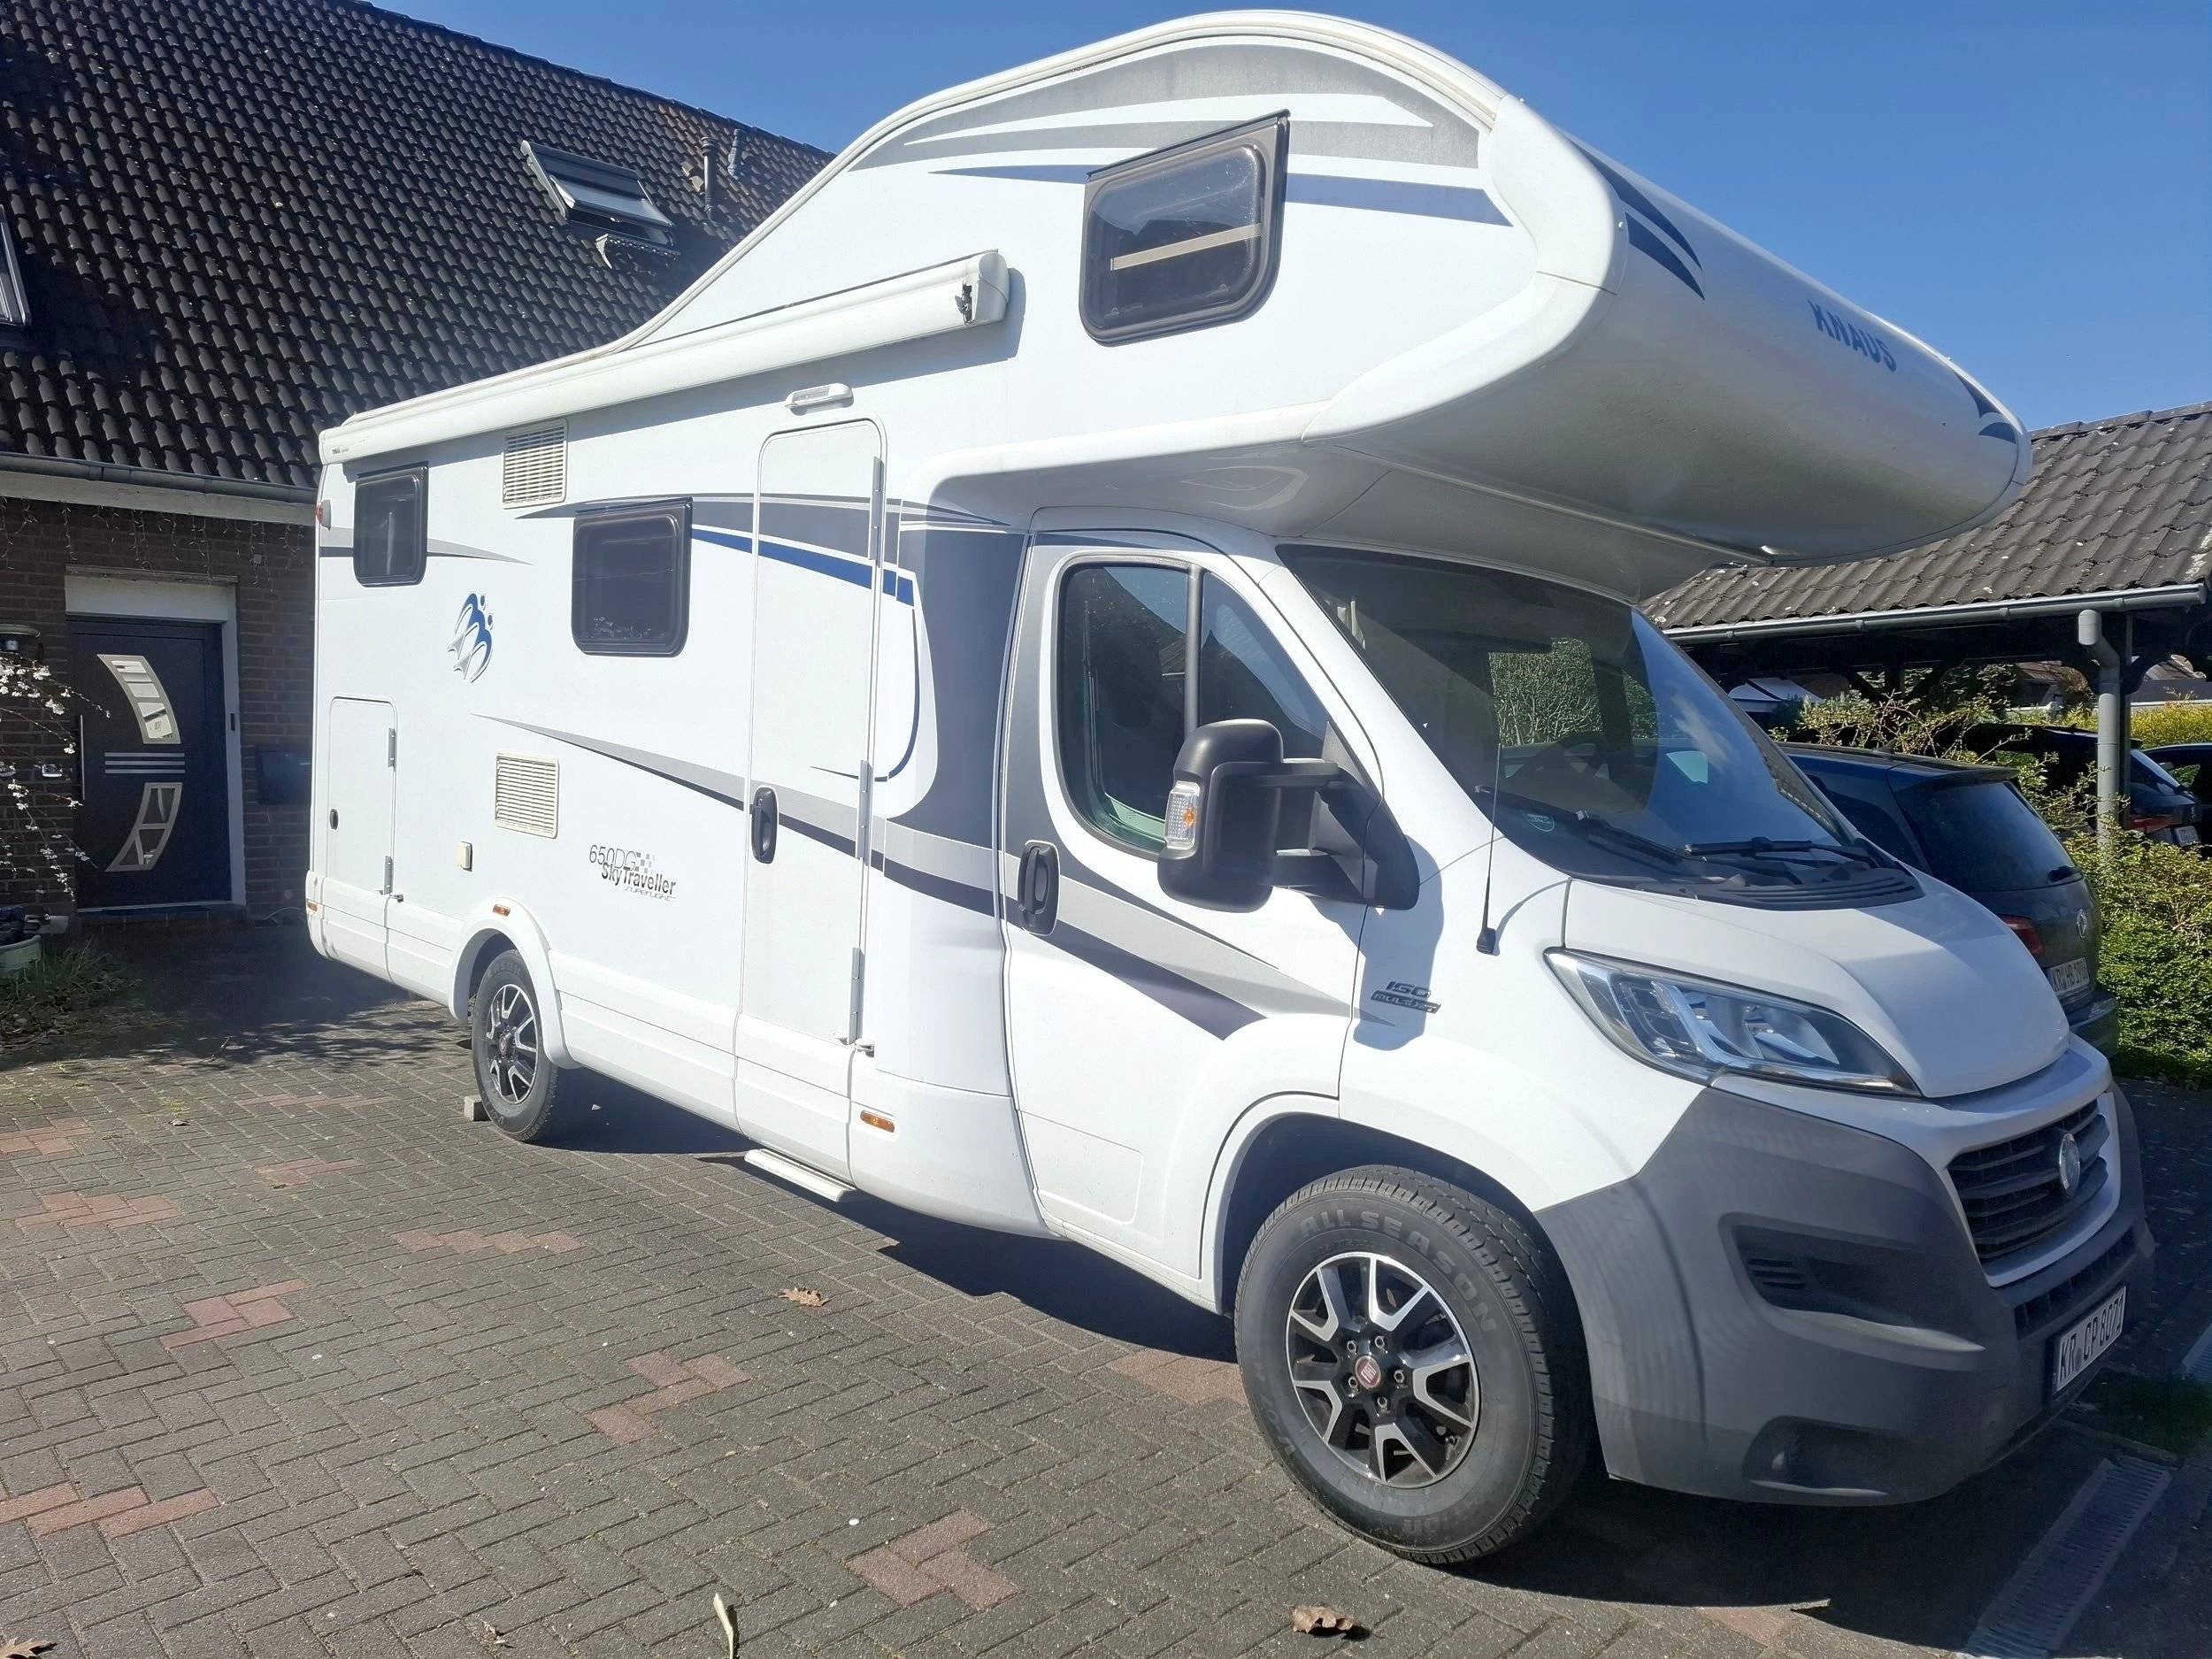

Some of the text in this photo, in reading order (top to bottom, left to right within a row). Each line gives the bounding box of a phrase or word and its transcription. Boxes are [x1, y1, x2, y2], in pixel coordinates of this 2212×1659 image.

[1807, 299, 1897, 373] KNAUS
[1386, 981, 1432, 999] 150
[1299, 1210, 1497, 1333] ALL SEASON
[2059, 1333, 2077, 1381] KR
[2084, 1316, 2098, 1361] CP
